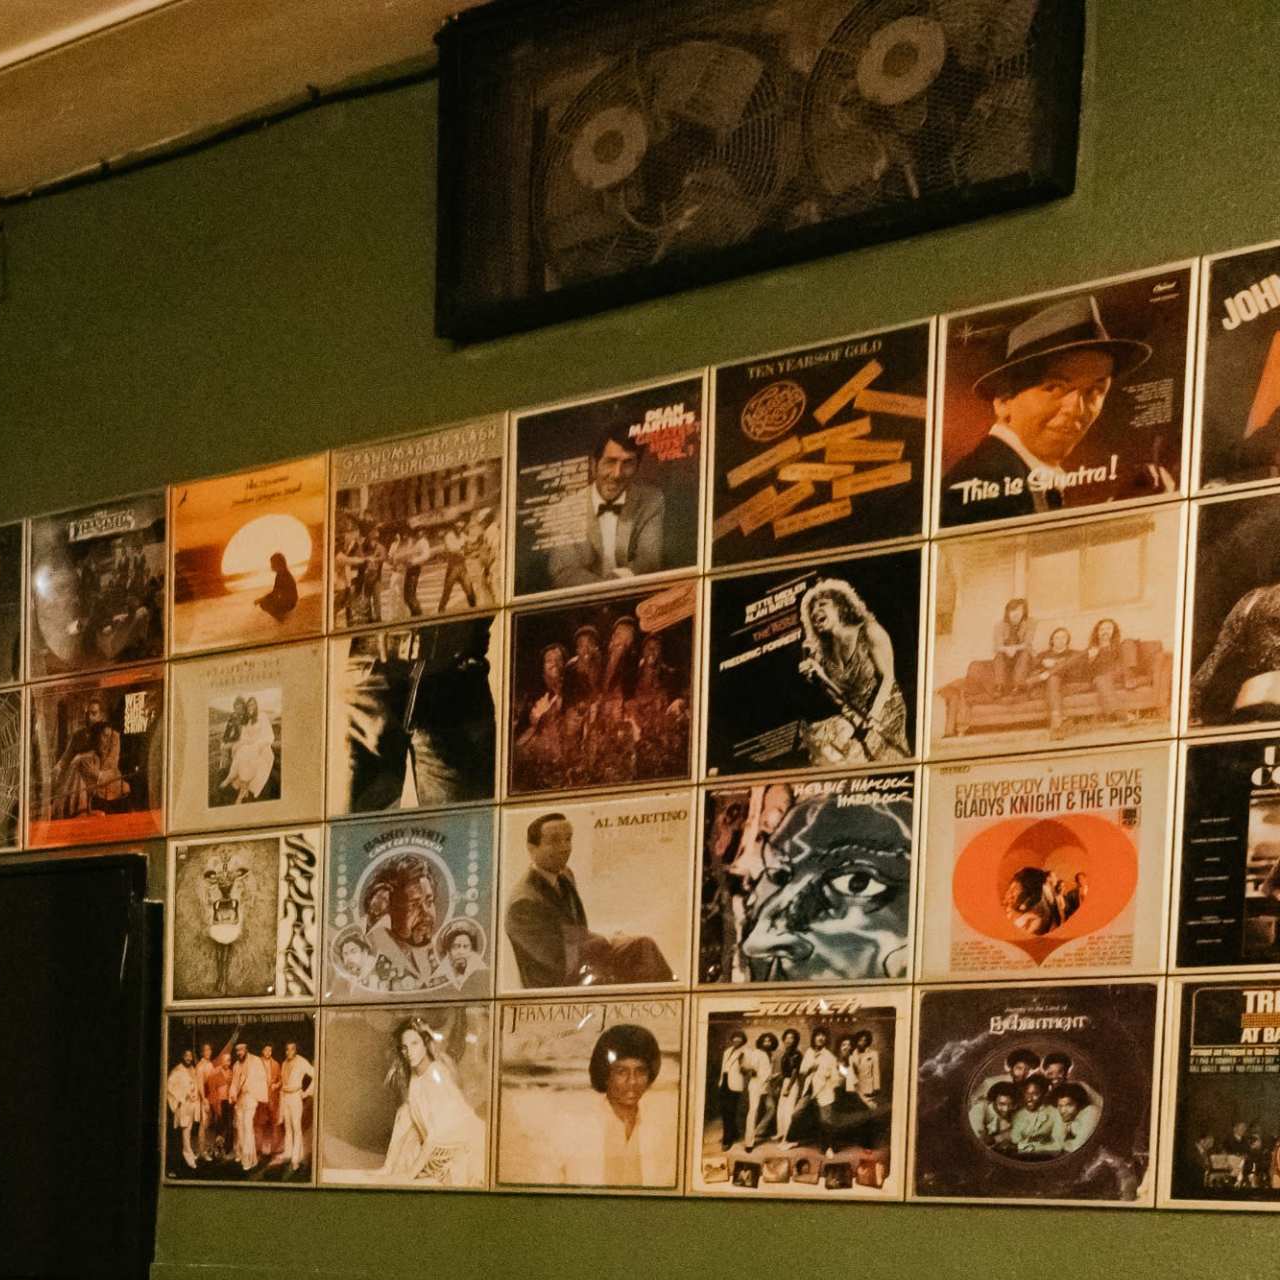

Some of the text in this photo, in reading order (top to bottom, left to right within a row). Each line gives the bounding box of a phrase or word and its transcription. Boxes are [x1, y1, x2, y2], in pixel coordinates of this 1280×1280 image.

[747, 363, 774, 379] TEN
[844, 339, 883, 358] GOLD
[949, 453, 1119, 505] This is Sinatra!
[793, 779, 844, 797] HERBIE
[1049, 773, 1099, 793] NEEDS
[954, 785, 1143, 820] GLADYS KNIGHT & THE PIPS
[593, 809, 688, 829] AL MARTINO
[597, 1001, 678, 1033] JACKSON
